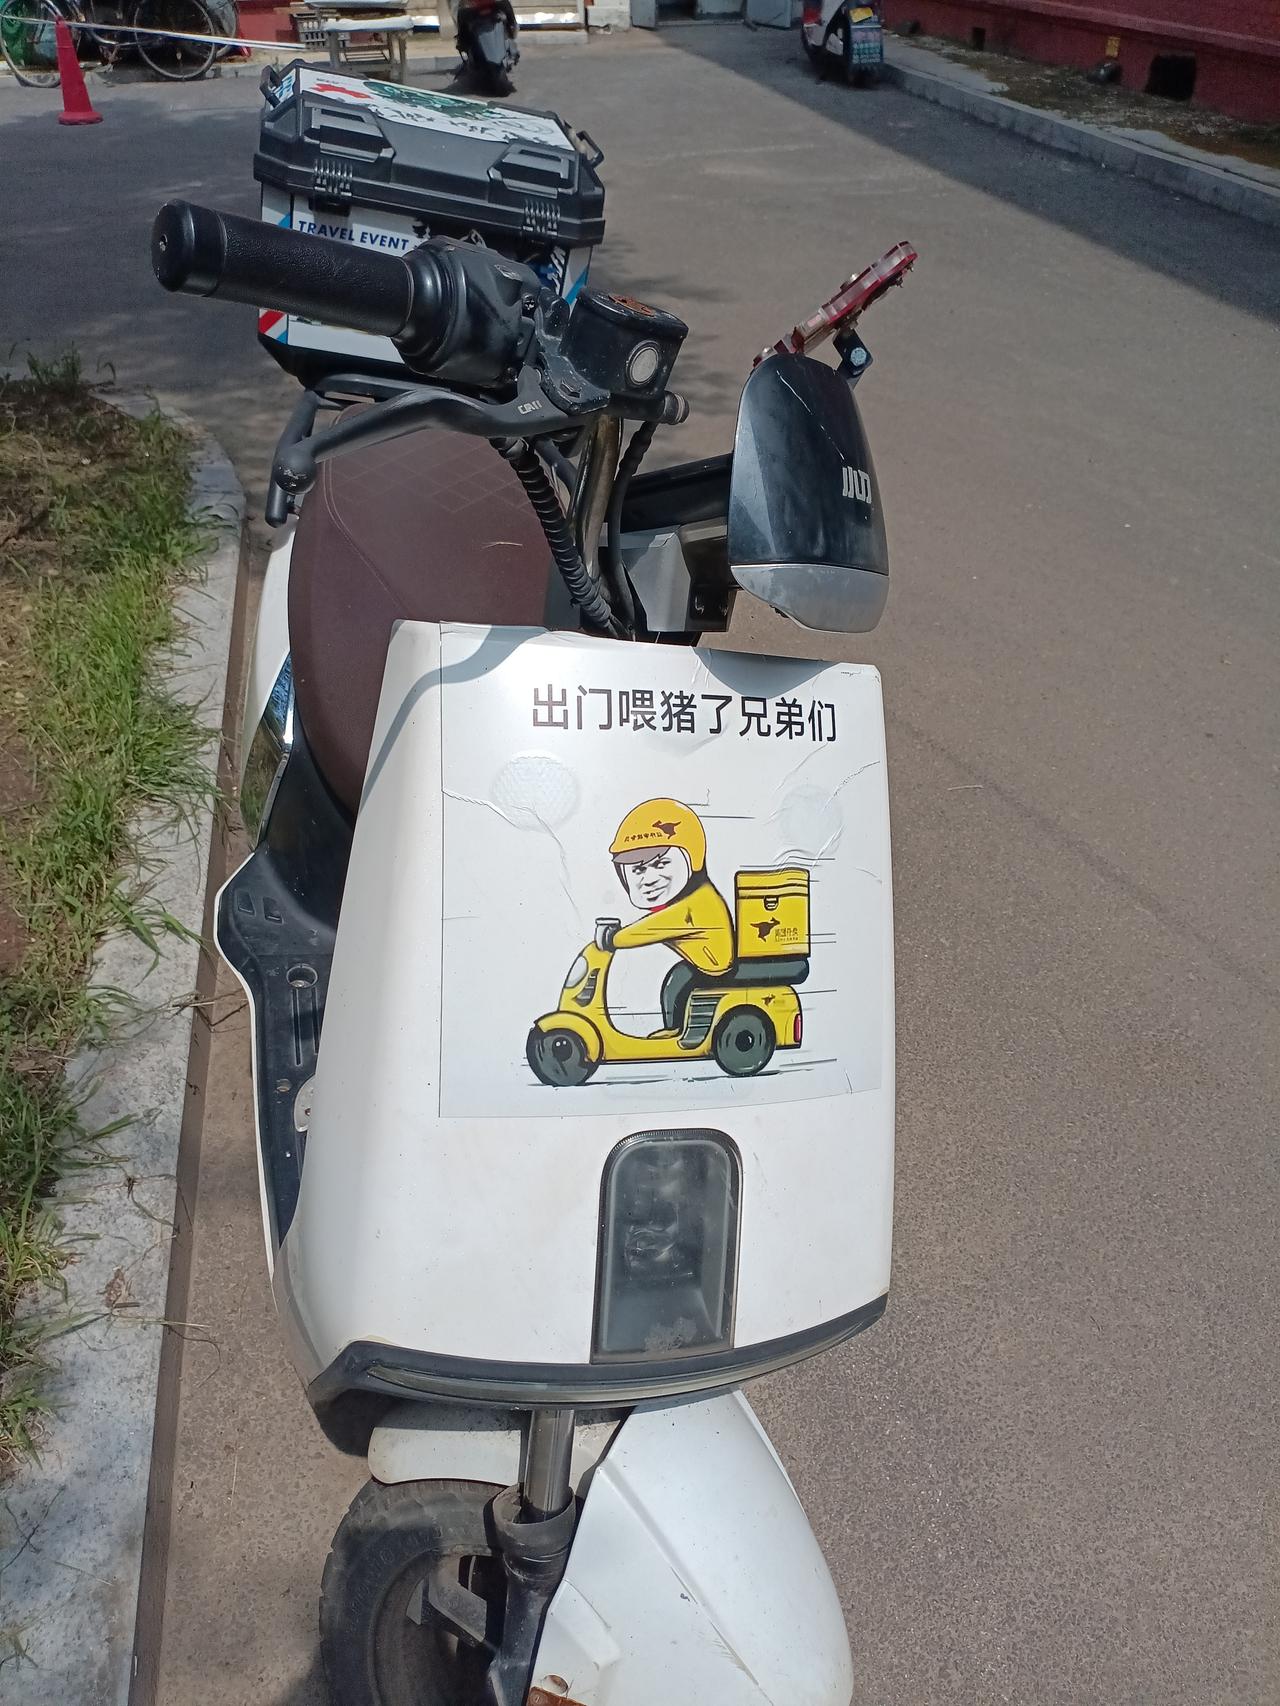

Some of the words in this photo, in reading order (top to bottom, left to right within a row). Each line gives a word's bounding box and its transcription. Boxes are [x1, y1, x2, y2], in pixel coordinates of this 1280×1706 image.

[298, 220, 354, 241] TRAVEL
[360, 231, 409, 251] EVENT
[533, 684, 837, 742] 出门喂猪了兄弟们
